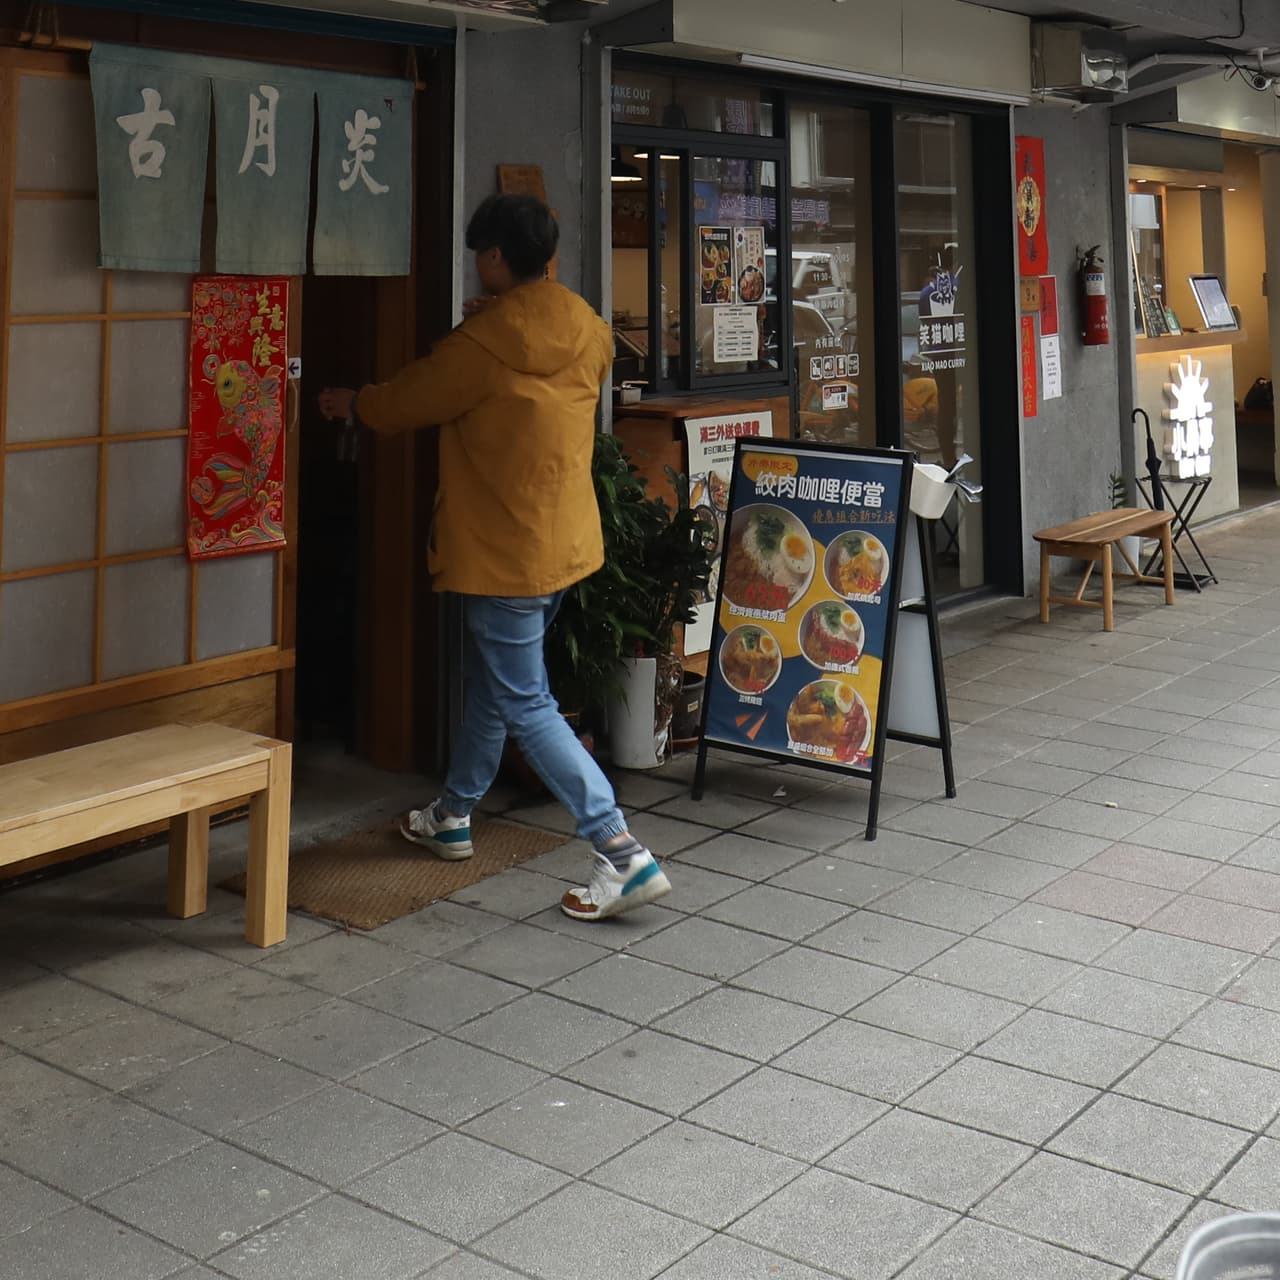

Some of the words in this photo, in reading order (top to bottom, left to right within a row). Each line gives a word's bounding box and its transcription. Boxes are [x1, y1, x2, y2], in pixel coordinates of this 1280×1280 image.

[633, 87, 652, 102] OUT
[116, 84, 390, 195] 古月炎
[935, 359, 948, 370] MAO
[948, 357, 967, 369] CURRY
[754, 471, 885, 508] 絞肉咖哩便當
